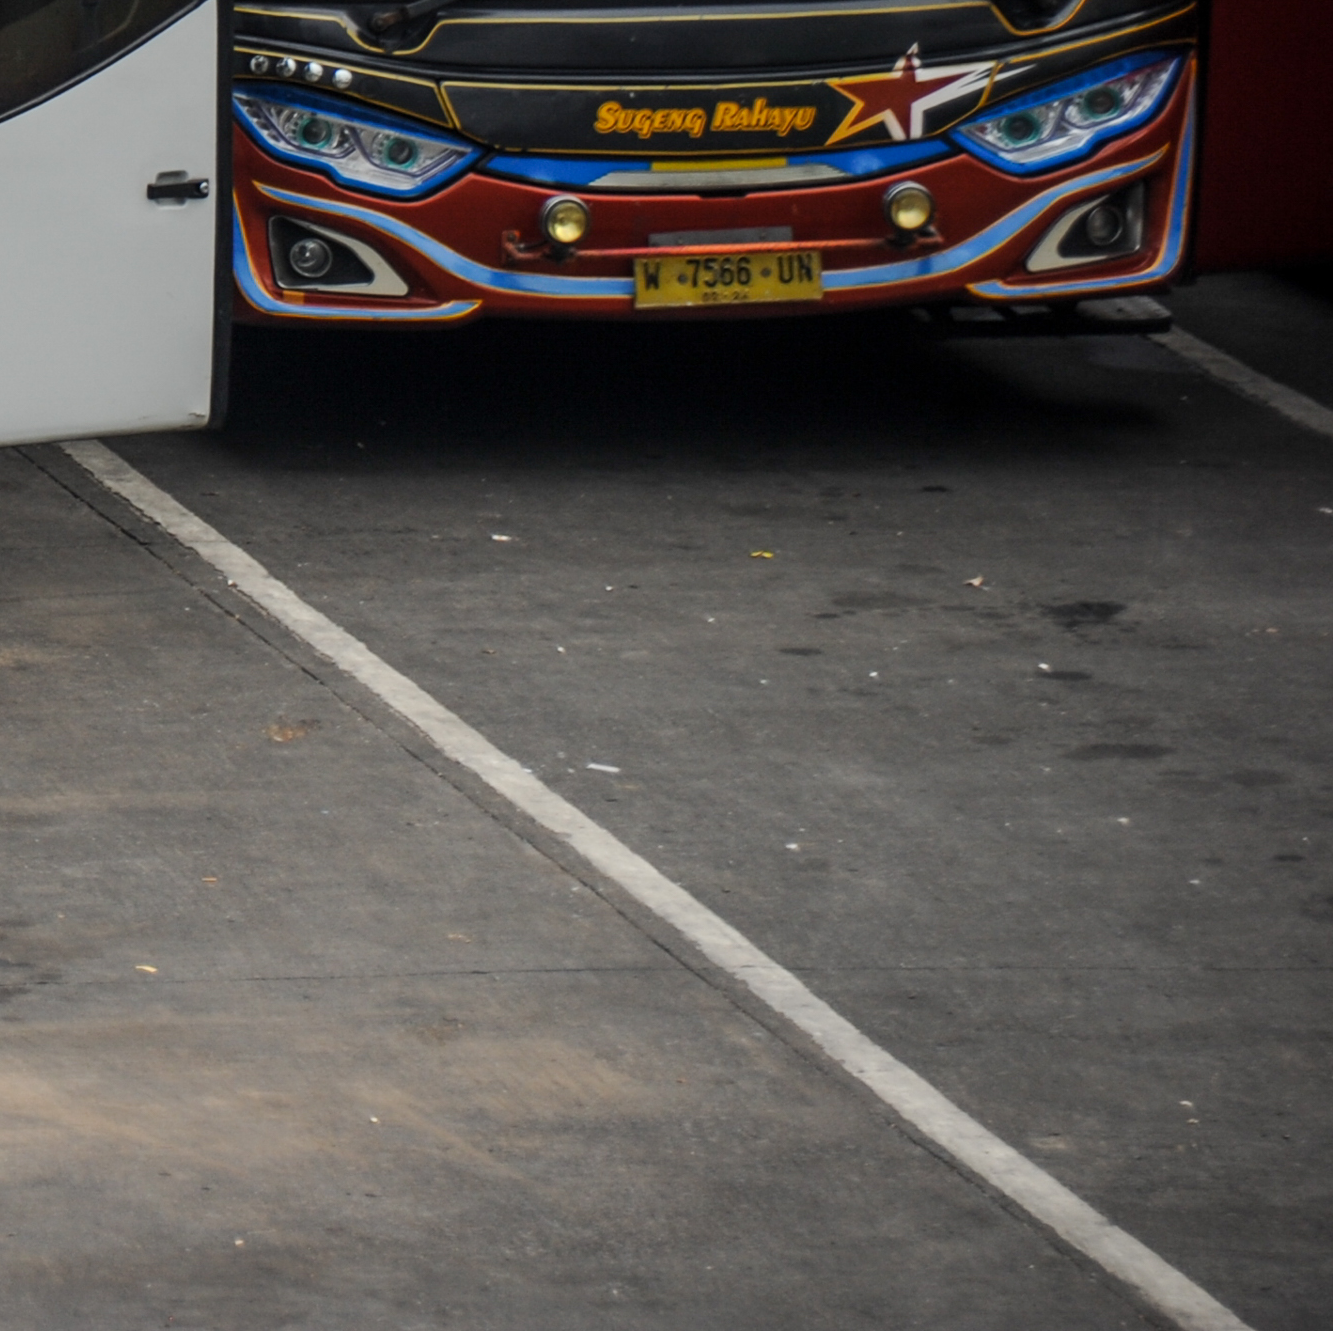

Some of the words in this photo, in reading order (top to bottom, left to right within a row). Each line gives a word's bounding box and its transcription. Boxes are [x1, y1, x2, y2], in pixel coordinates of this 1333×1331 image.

[642, 261, 661, 291] W
[686, 256, 752, 289] 7566
[776, 252, 814, 285] UN
